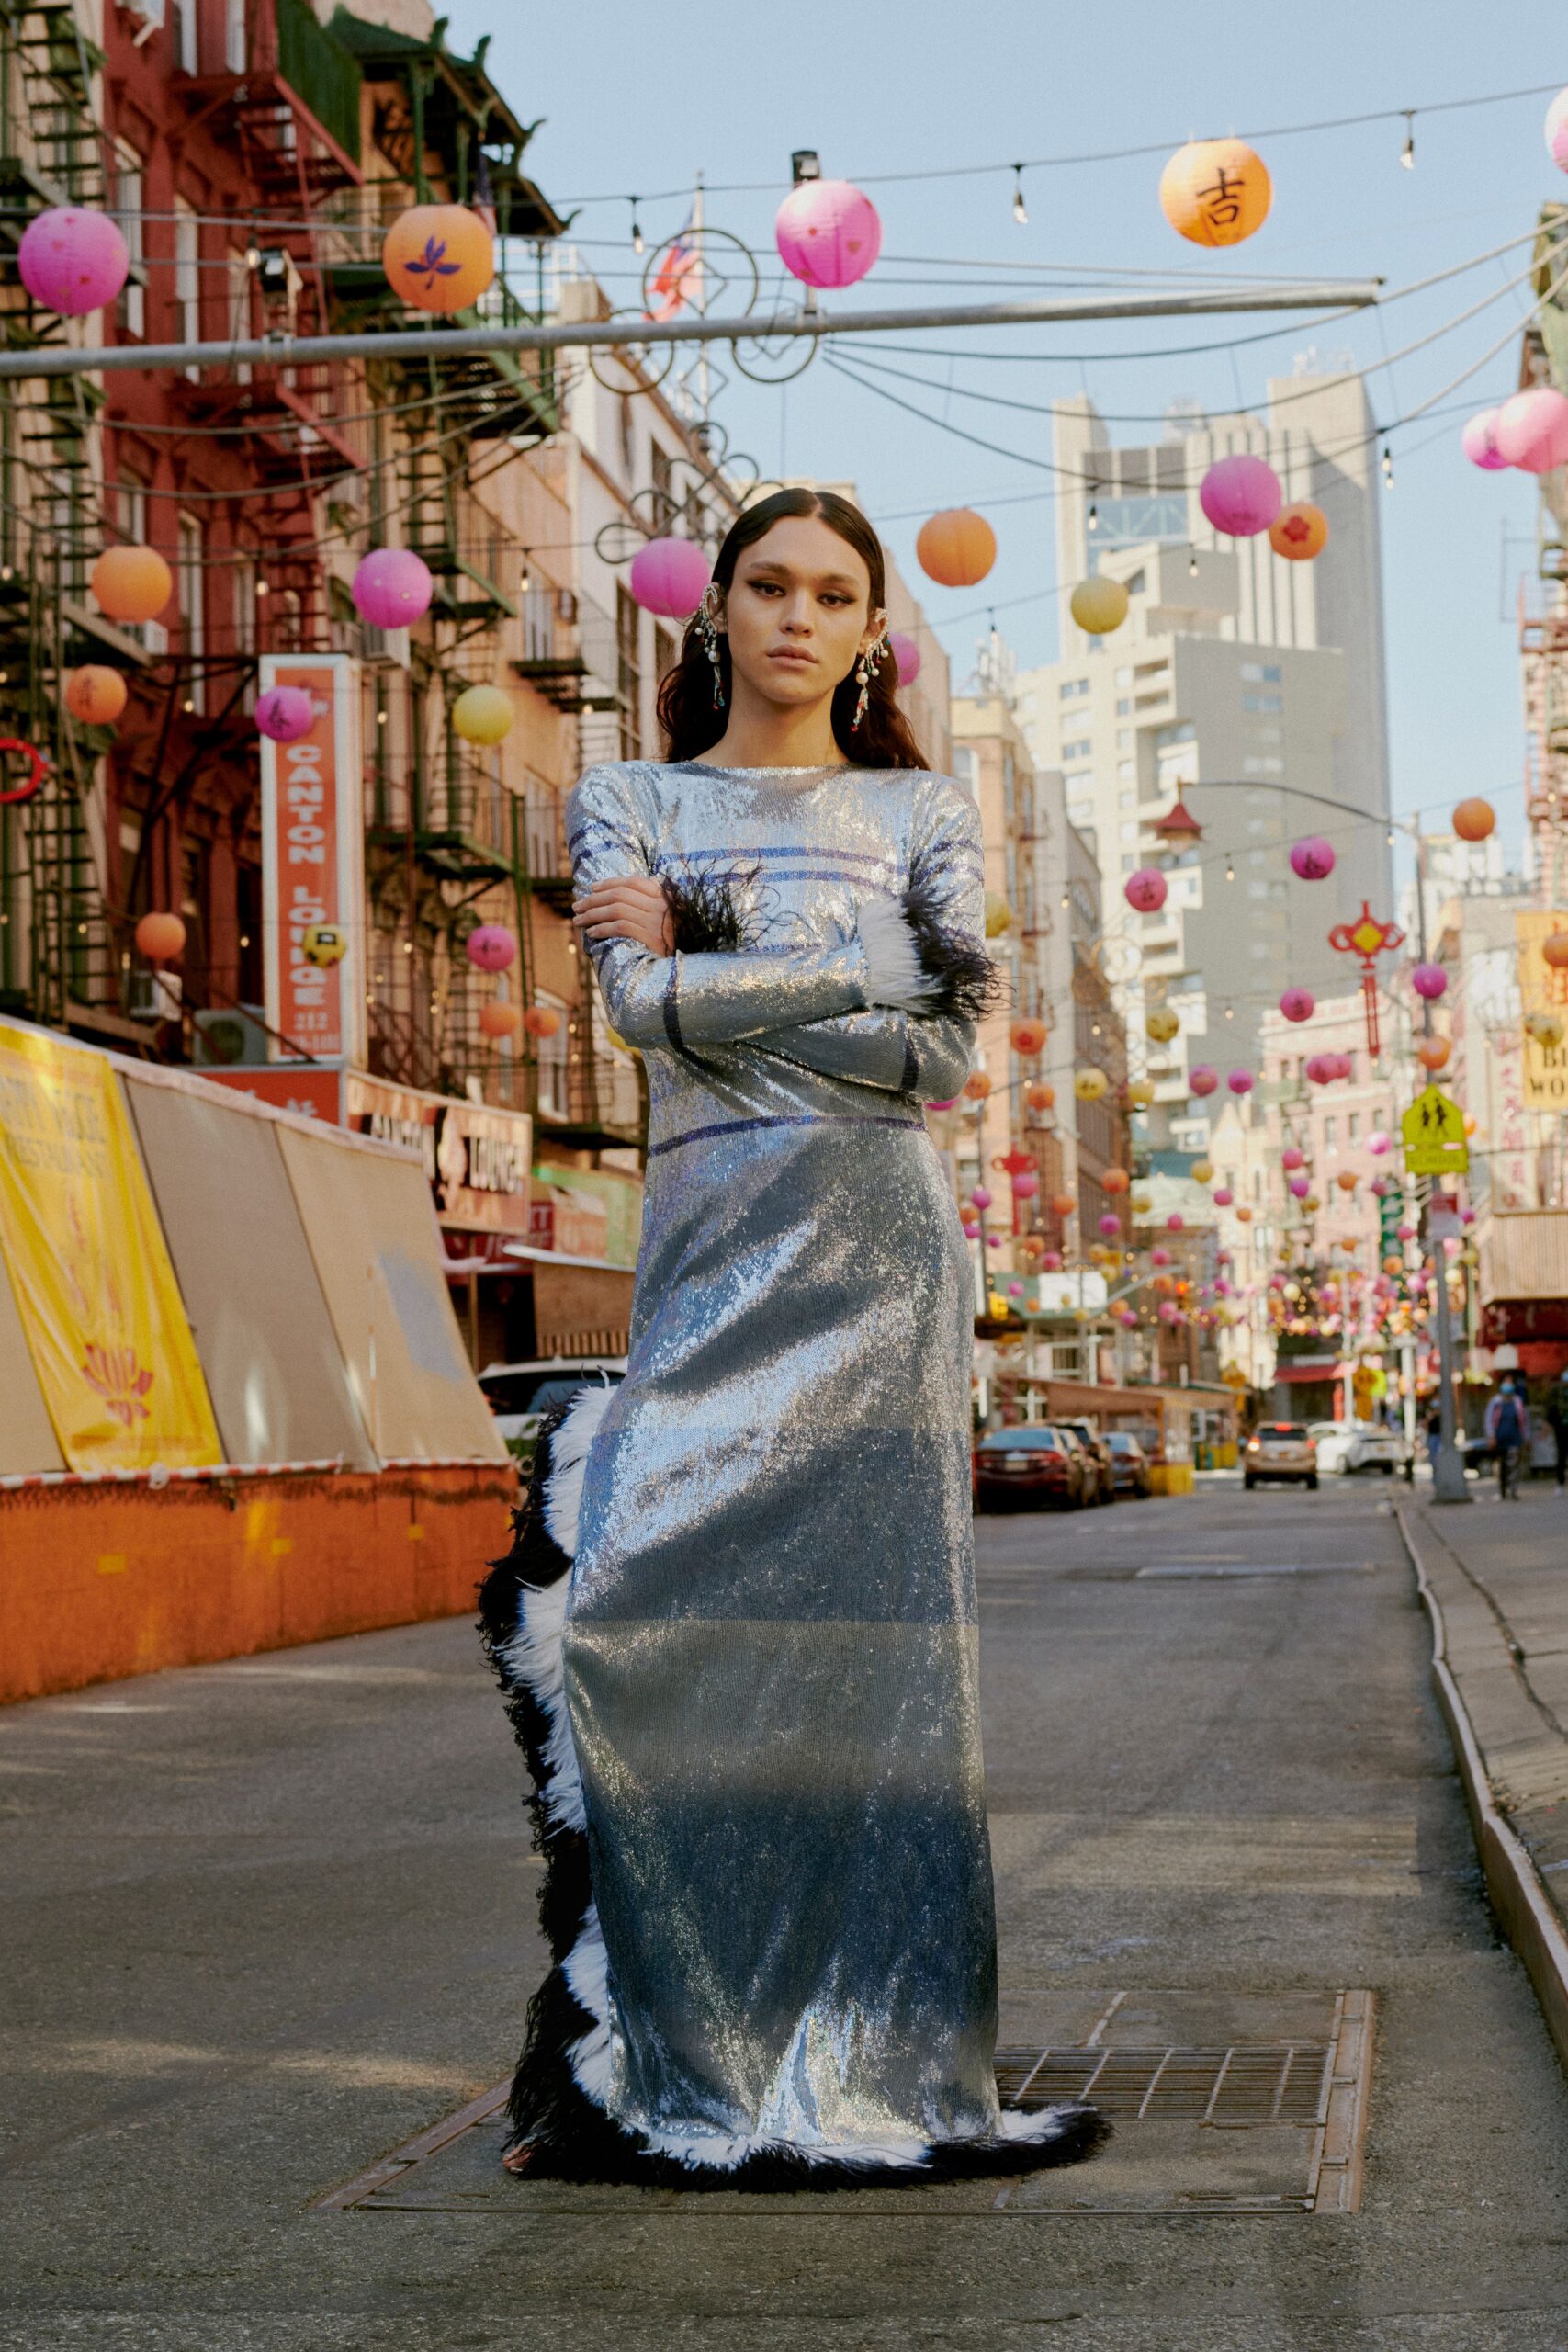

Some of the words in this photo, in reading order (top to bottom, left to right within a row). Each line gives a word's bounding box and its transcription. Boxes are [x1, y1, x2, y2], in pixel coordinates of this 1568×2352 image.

[1196, 167, 1245, 226] 吉
[286, 744, 325, 865] CANTON
[293, 1012, 328, 1031] 212
